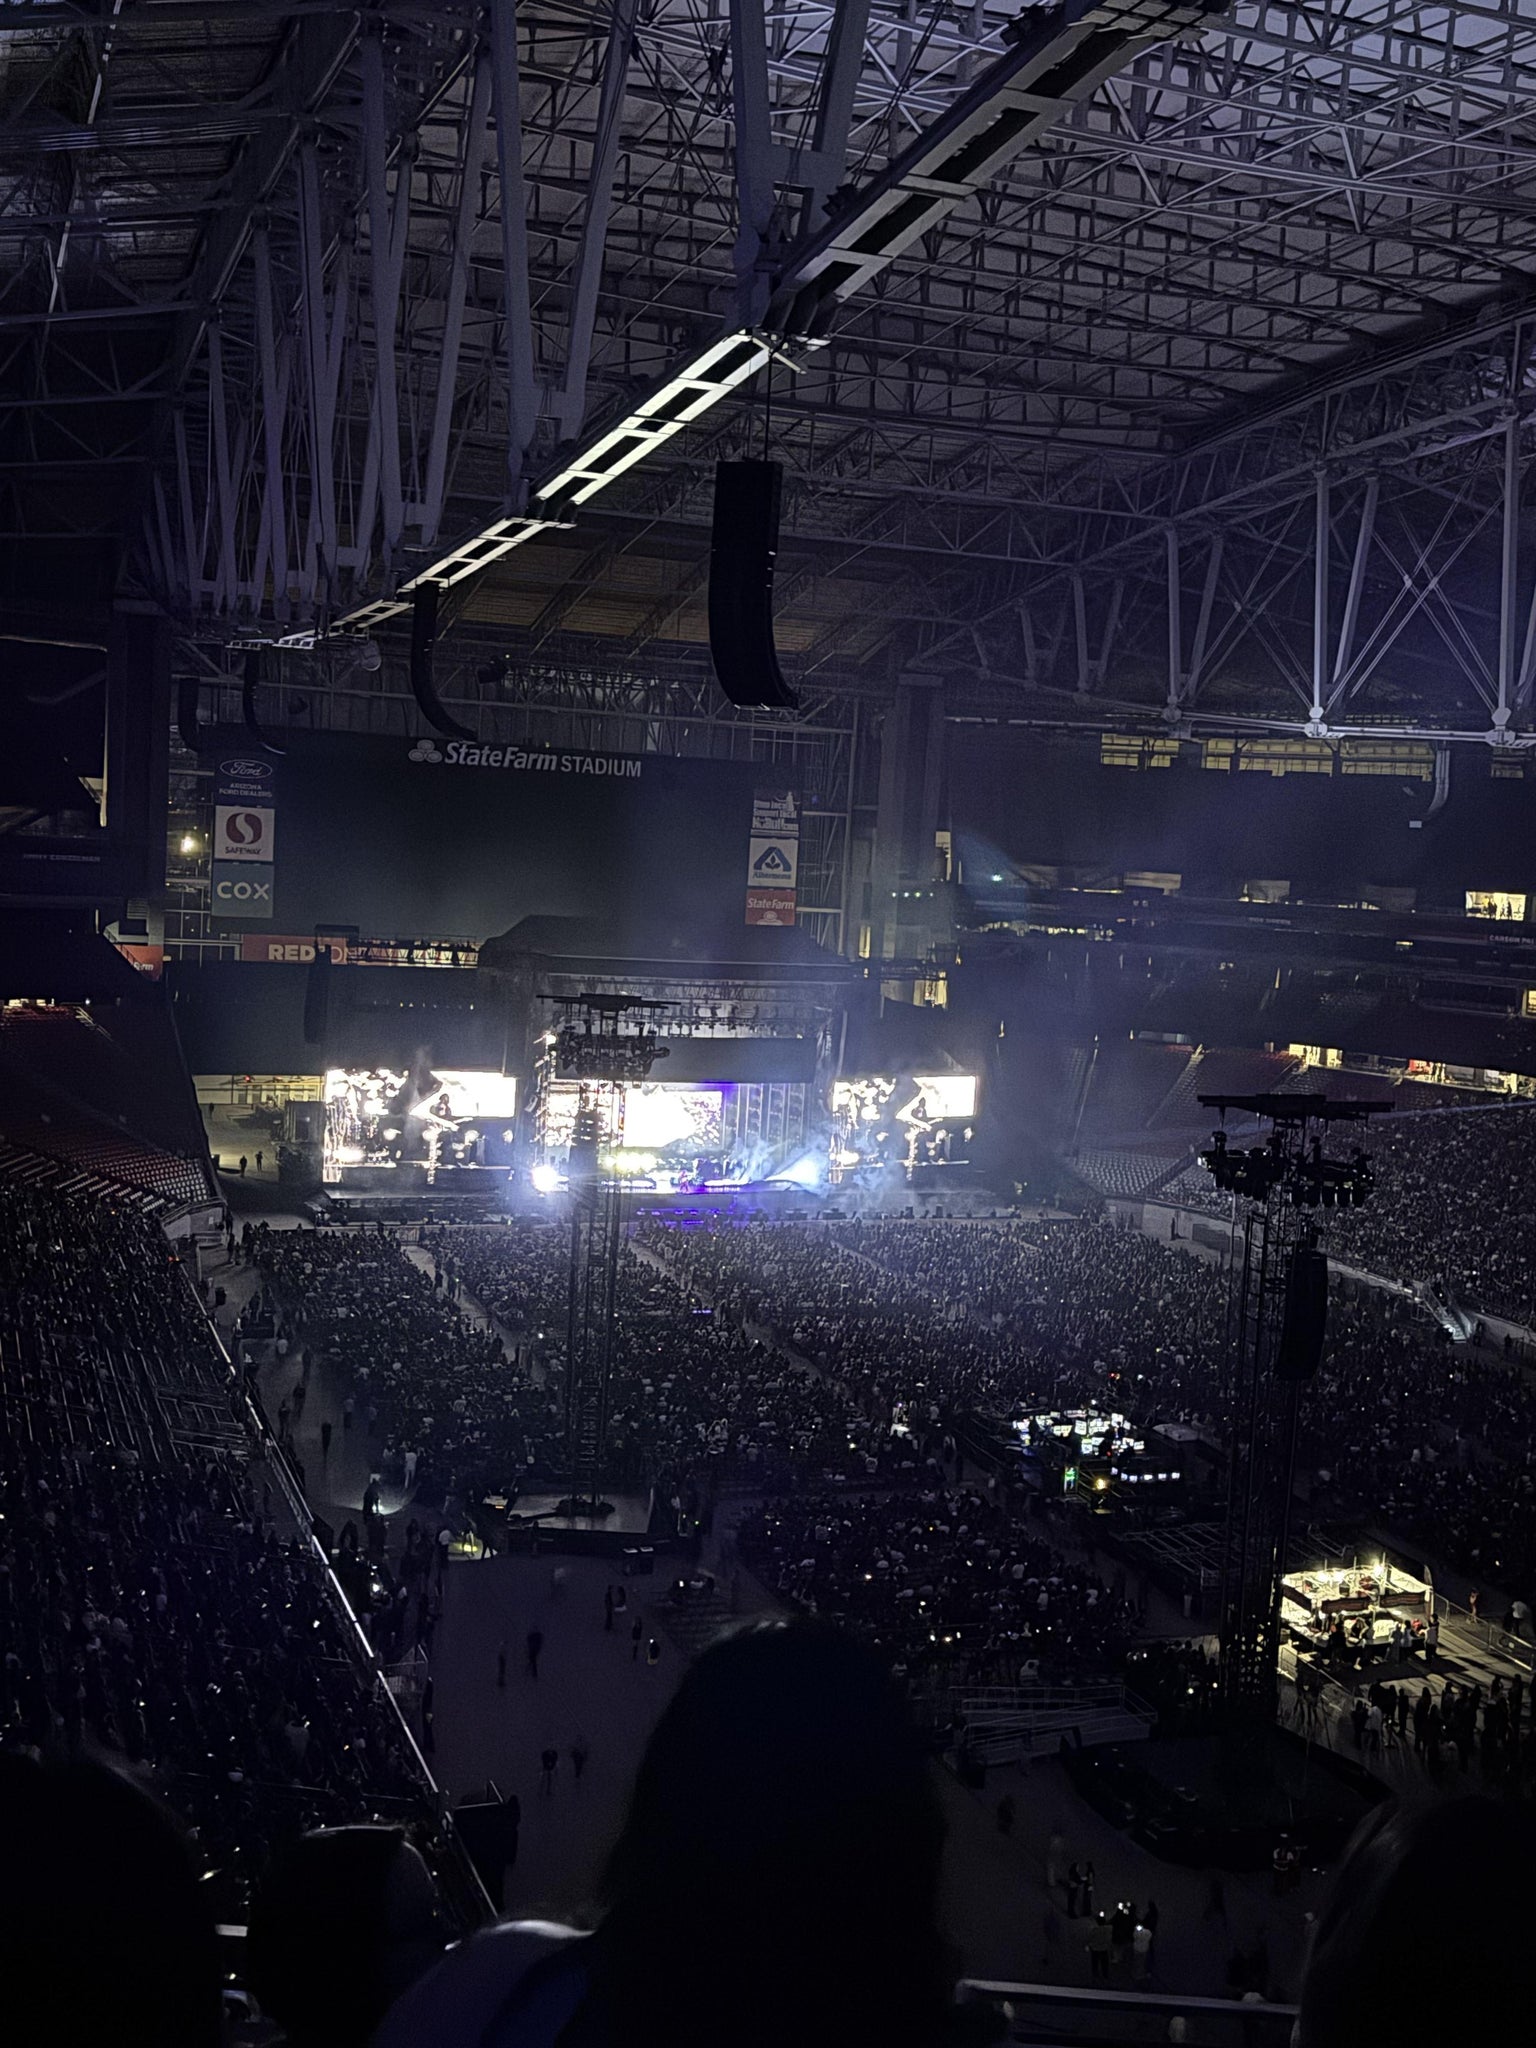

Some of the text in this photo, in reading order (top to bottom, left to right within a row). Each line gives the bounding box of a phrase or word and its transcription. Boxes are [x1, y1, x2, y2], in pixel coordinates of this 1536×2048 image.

[230, 761, 264, 776] Ford
[559, 755, 641, 778] STADIUM
[225, 846, 262, 855] SAFEWAY
[216, 881, 270, 901] COX
[268, 944, 316, 961] RED
